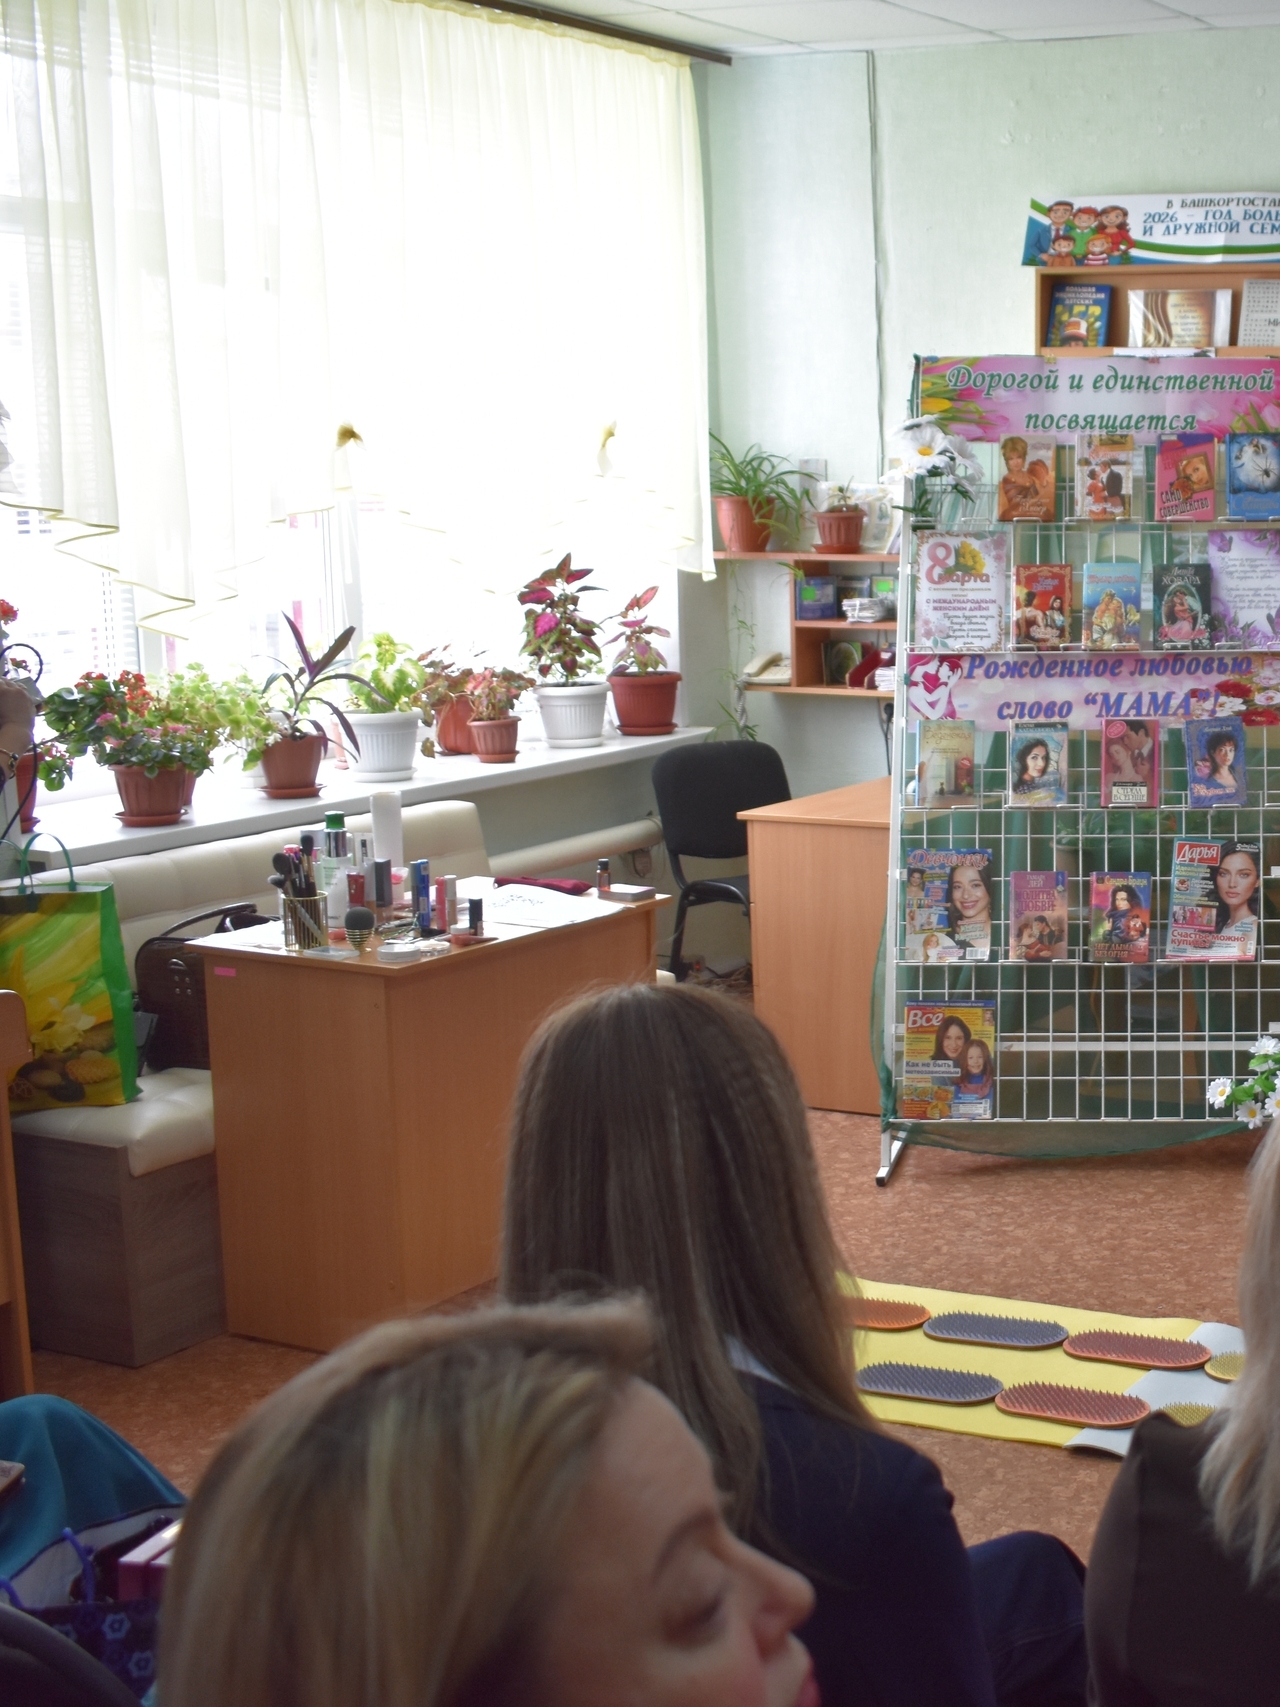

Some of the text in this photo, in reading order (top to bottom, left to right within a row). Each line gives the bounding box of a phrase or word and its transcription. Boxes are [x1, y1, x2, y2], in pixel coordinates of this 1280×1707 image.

[1166, 199, 1174, 209] В
[1143, 211, 1178, 224] 2026
[1204, 209, 1234, 222] ГОД
[1143, 224, 1153, 236] И
[1162, 221, 1240, 236] ДРУЖНОЙ
[946, 363, 1275, 398] Дорогой и единственной
[1024, 409, 1198, 433] посвящается
[1160, 488, 1183, 504] САМО
[1159, 497, 1210, 518] СОВЕРШЕНСТВО
[925, 541, 953, 585] 8
[938, 572, 990, 586] марта
[1162, 577, 1201, 585] ХОВАРД
[968, 604, 990, 612] ДНЁМ!
[964, 653, 1253, 681] Рожденное любовью
[997, 698, 1073, 720] слово
[910, 849, 989, 870] Девчонки
[1177, 844, 1218, 865] Дарья
[1028, 880, 1043, 888] ЛЕЙ
[1104, 874, 1148, 888] Сандра Браун
[1171, 929, 1246, 943] Счастье можно
[1094, 943, 1109, 951] НЕТ
[1094, 950, 1107, 958] БЕЗ
[908, 1009, 944, 1028] Все
[905, 1060, 919, 1068] Как
[932, 1060, 952, 1068] быть
